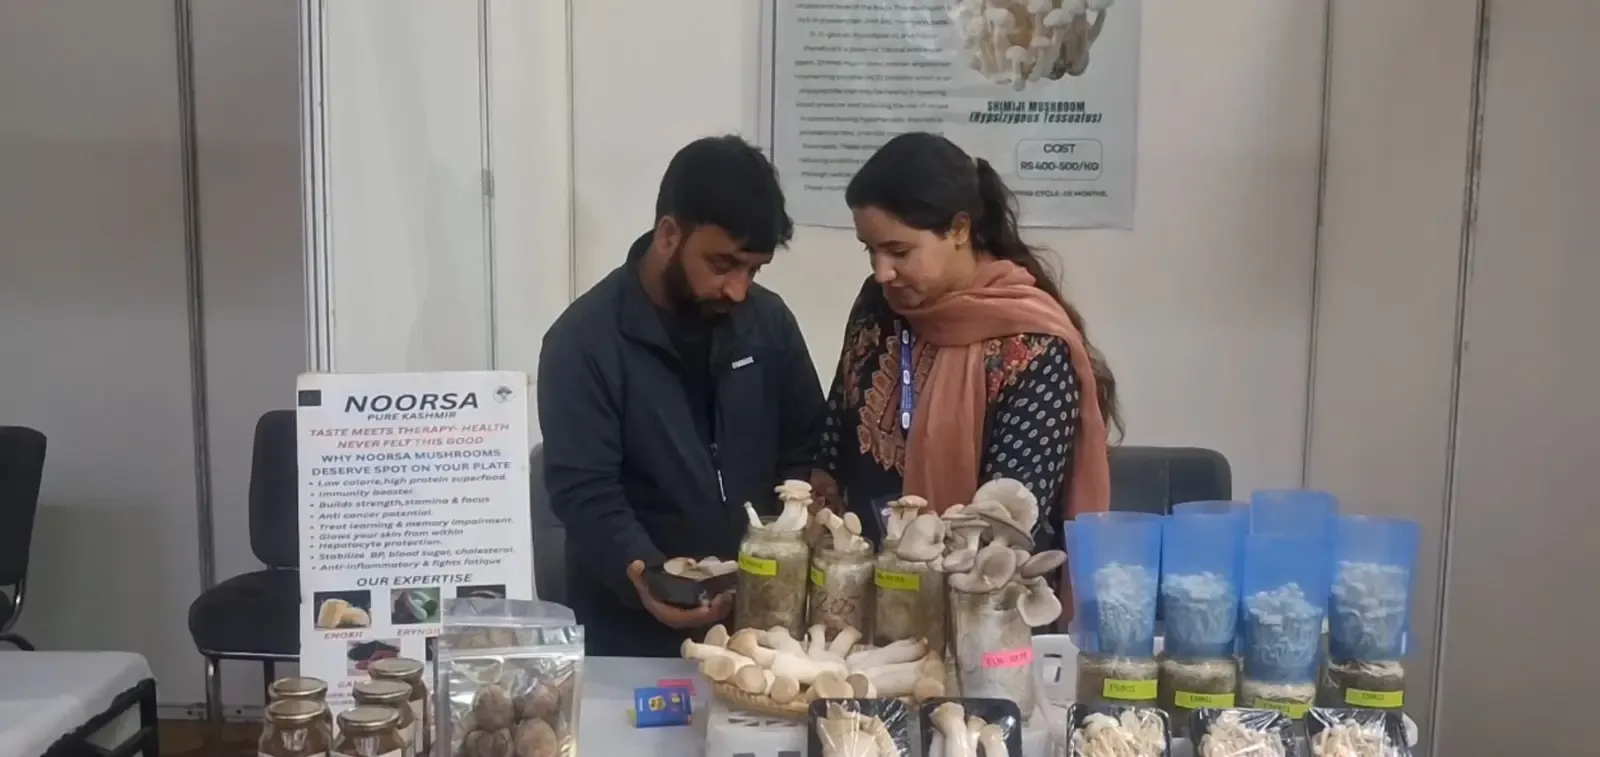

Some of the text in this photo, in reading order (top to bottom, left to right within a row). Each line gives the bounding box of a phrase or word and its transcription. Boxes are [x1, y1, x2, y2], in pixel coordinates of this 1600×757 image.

[1028, 101, 1085, 112] MUSHROOM
[1043, 143, 1077, 154] COST
[1020, 161, 1034, 170] RS
[344, 392, 479, 413] NOORSA
[367, 411, 457, 421] PURE KASHMIR
[309, 428, 349, 437] TASTE
[351, 426, 394, 436] MEETS
[461, 423, 509, 433] HEALTH
[337, 436, 484, 449] NEVER FELT THIS GOOD
[321, 449, 501, 464] WHY NOORSA MUSHROOMS
[312, 461, 512, 477] DESERVE SPOT ON YOUR PLATE
[317, 480, 341, 488] Low
[408, 476, 449, 486] protein
[450, 474, 506, 484] superfood
[318, 488, 414, 498] Immunity booster
[451, 496, 459, 504] &
[460, 496, 491, 504] focus
[318, 512, 342, 520] Anti
[342, 511, 380, 520] cancer
[319, 523, 348, 532] Treat
[349, 521, 394, 532] learning
[396, 520, 403, 528] &
[404, 520, 449, 529] memory
[353, 532, 379, 540] your
[380, 530, 402, 538] skin
[403, 529, 429, 537] from
[431, 528, 464, 536] within
[388, 550, 420, 558] blood
[422, 560, 430, 568] &
[356, 573, 474, 587] OUR EXPERTISE
